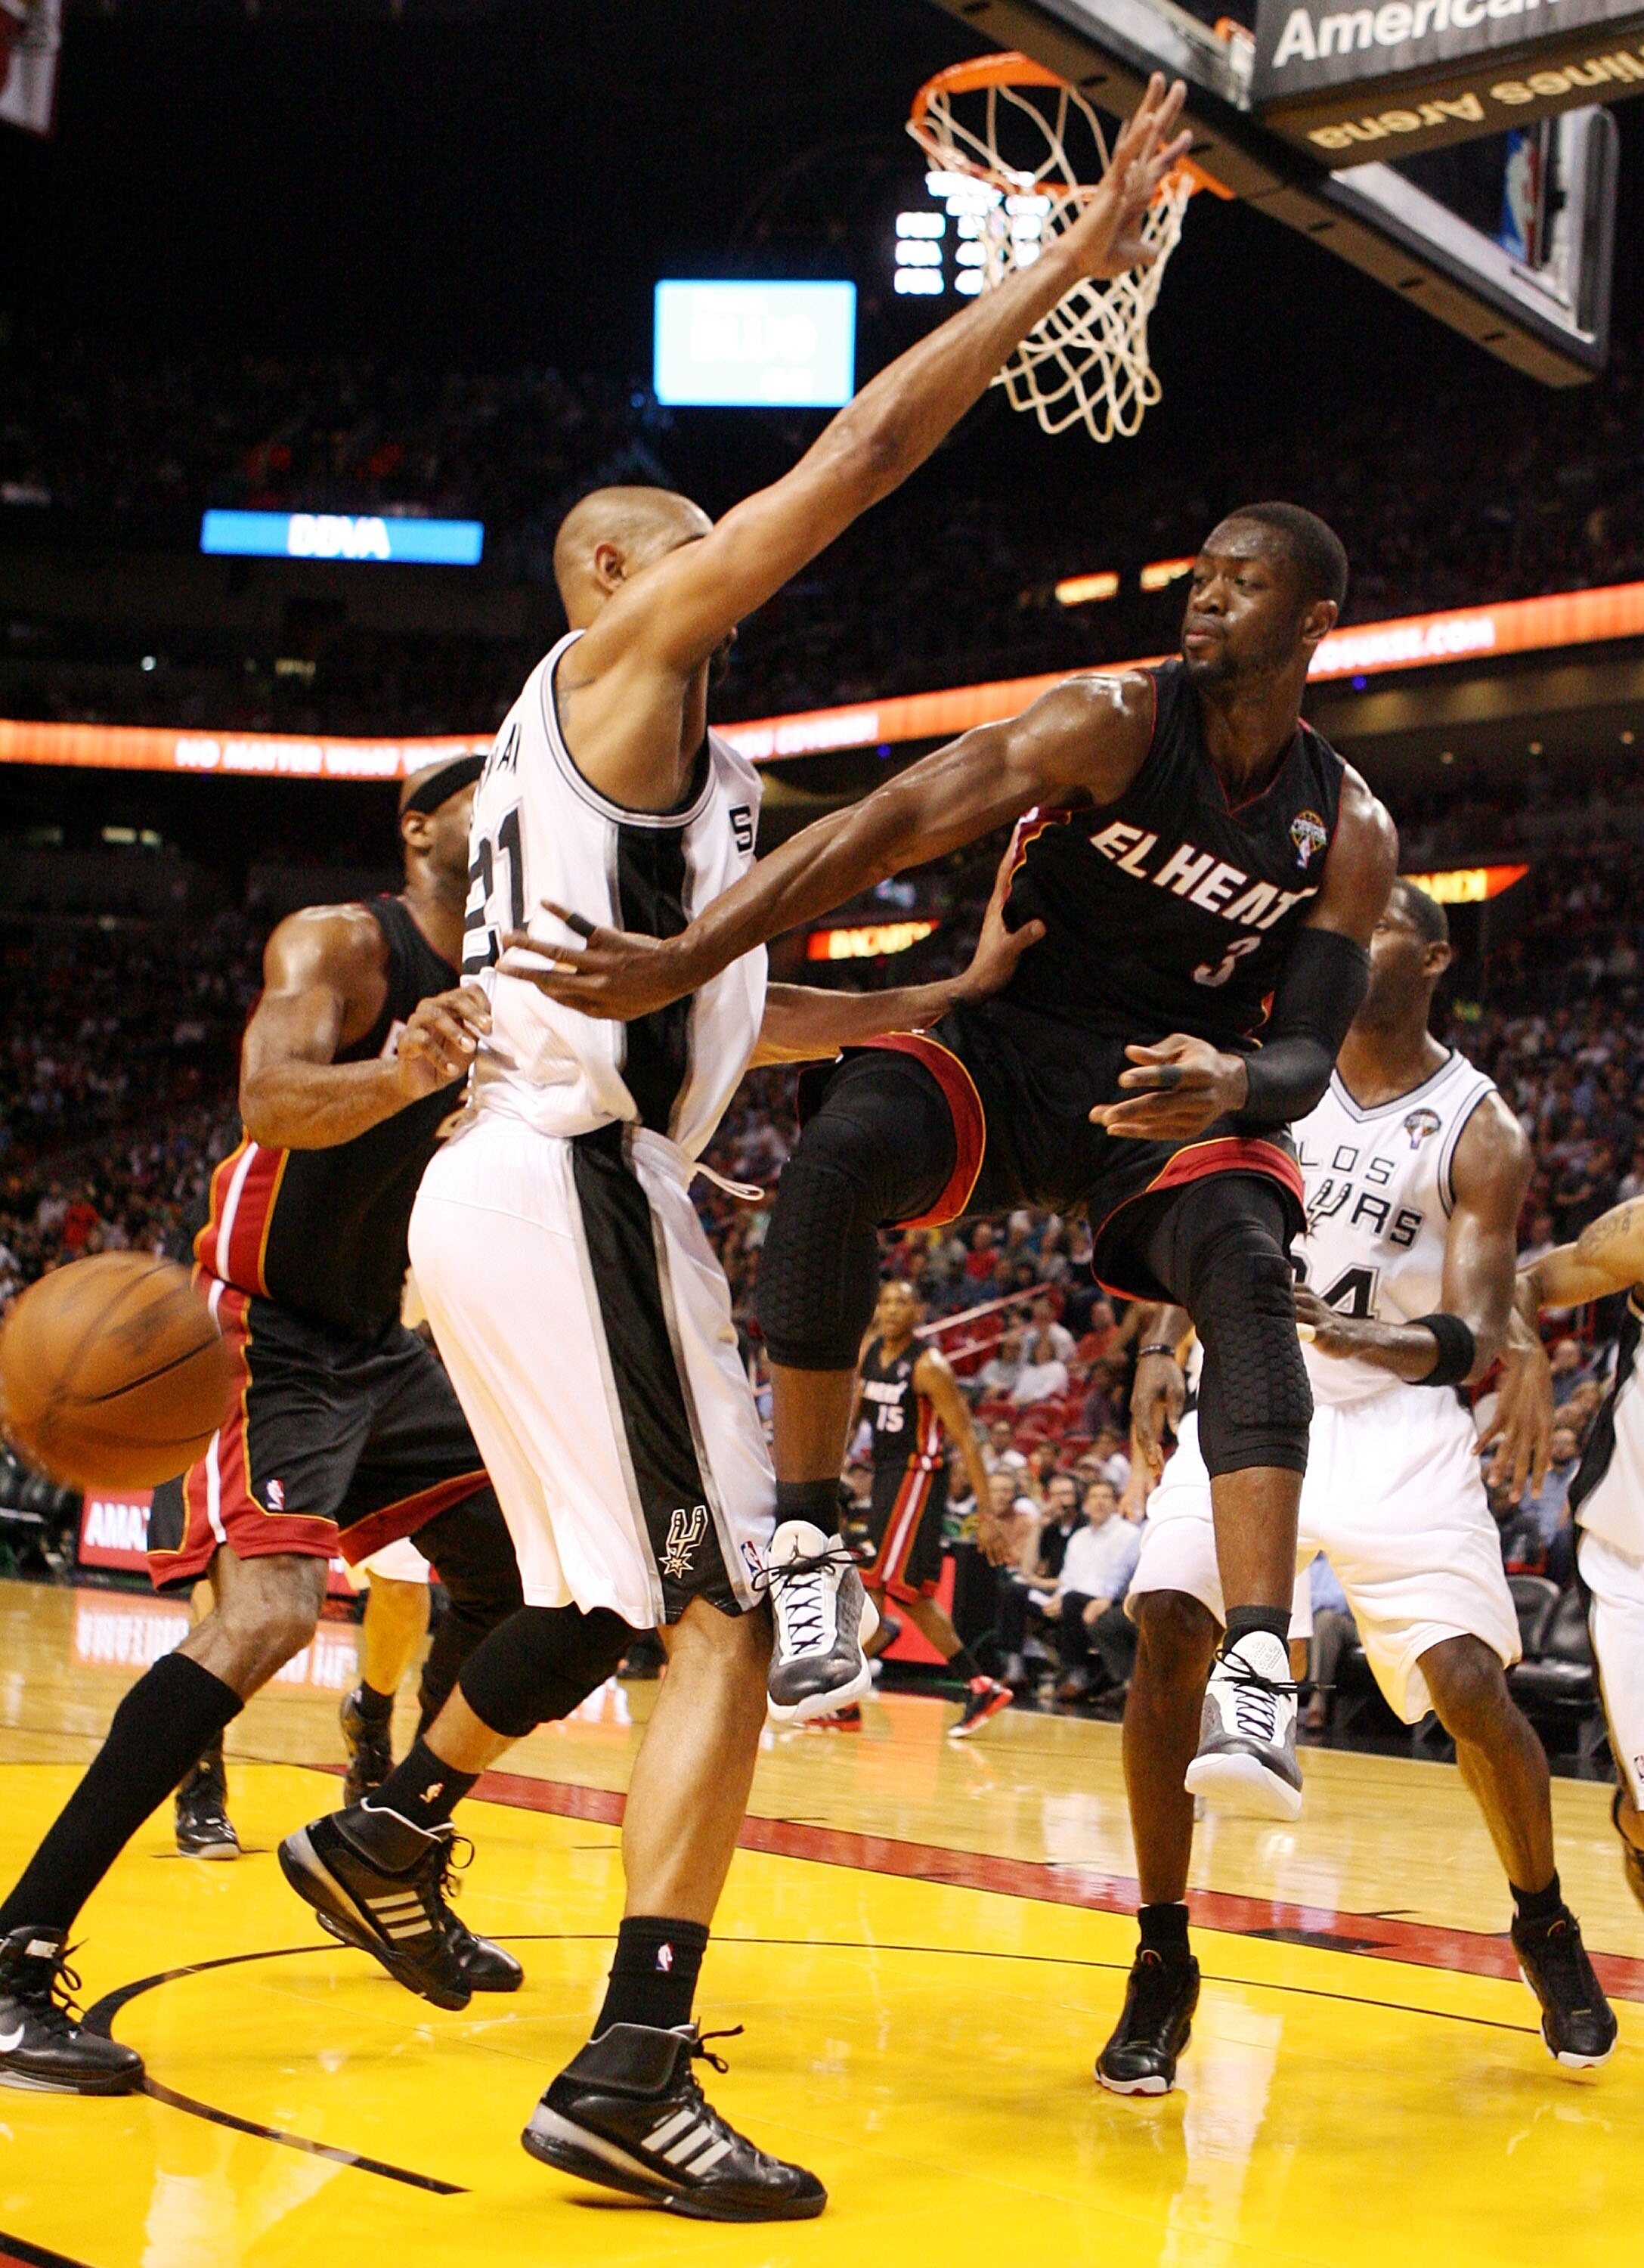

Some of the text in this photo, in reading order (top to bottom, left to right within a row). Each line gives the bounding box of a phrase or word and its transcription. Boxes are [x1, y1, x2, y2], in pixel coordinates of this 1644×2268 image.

[1273, 0, 1560, 69] America
[1308, 45, 1644, 149] lines Arena
[222, 739, 323, 772] MATTER
[1090, 820, 1158, 878] EL
[1153, 842, 1318, 931] HEAT
[1192, 934, 1262, 987] 3
[1299, 1140, 1395, 1185] LOS
[876, 1404, 905, 1433] 15
